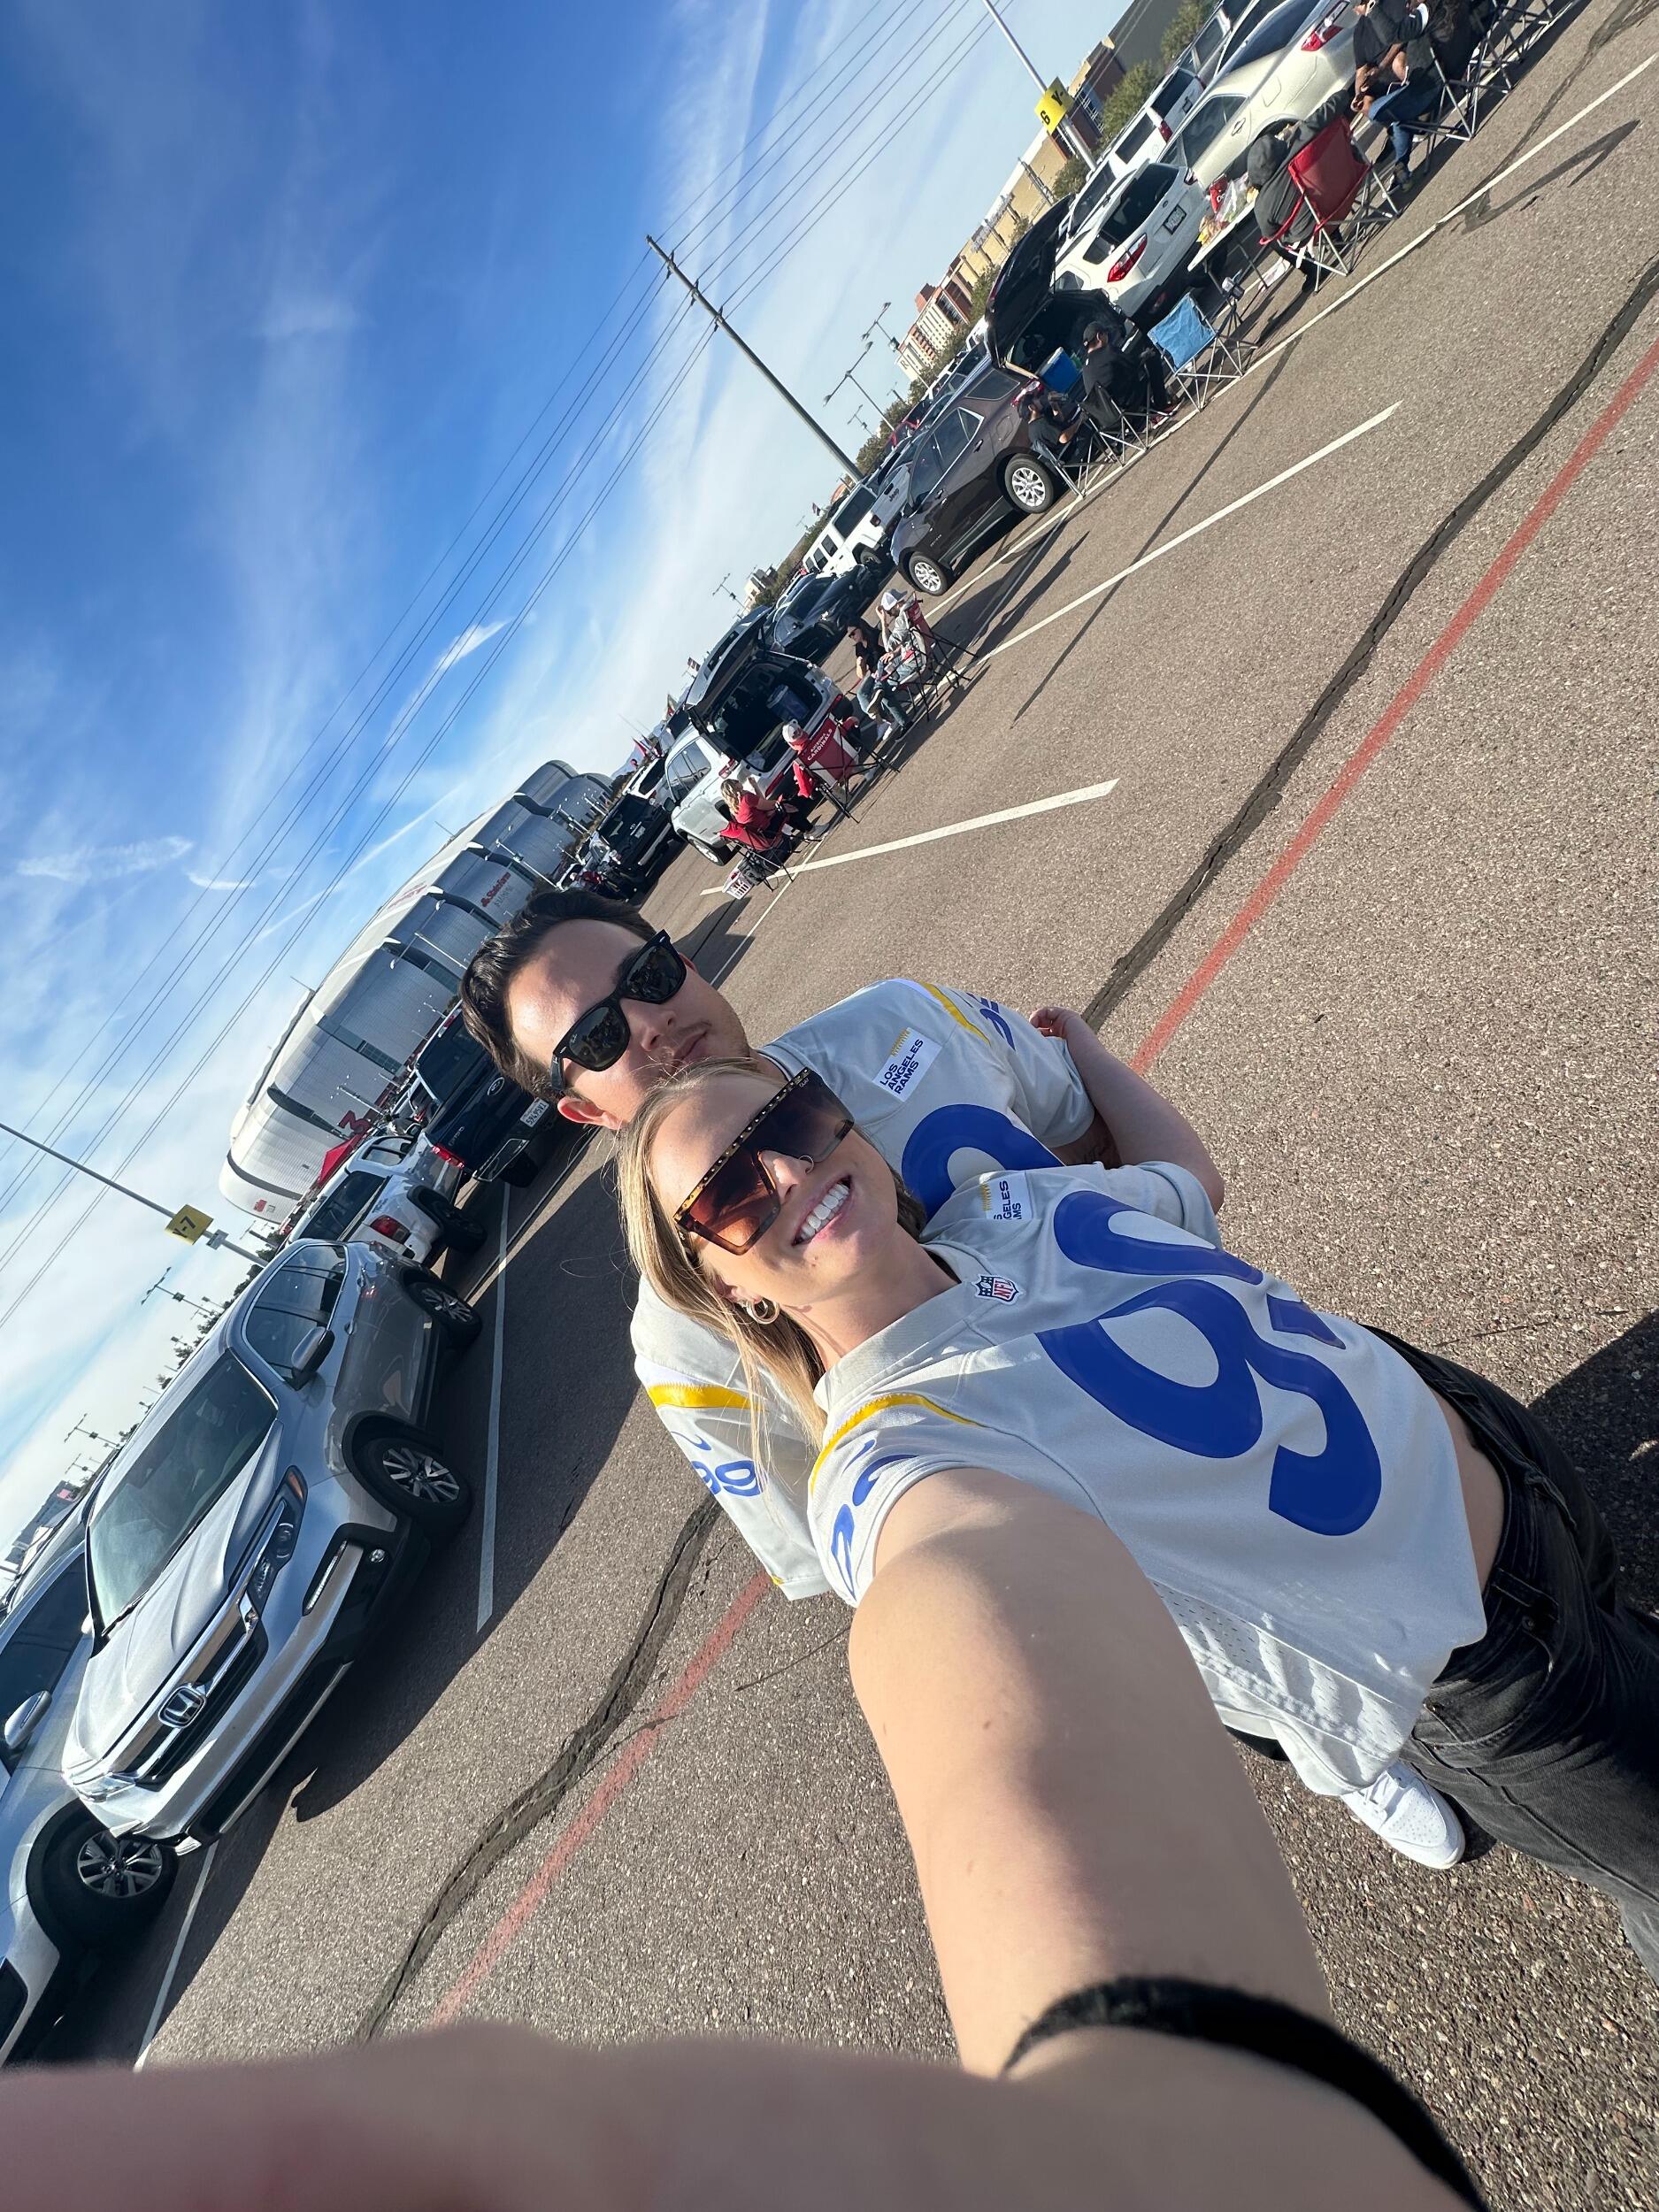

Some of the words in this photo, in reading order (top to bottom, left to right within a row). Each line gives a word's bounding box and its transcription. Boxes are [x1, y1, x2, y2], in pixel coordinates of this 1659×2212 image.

[807, 728, 833, 761] CARDINALS
[879, 1063, 898, 1087] LOS
[887, 1039, 924, 1091] ANGELES
[894, 1060, 920, 1094] RAMS
[1000, 1180, 1012, 1220] GELES
[994, 1280, 1014, 1299] NFL
